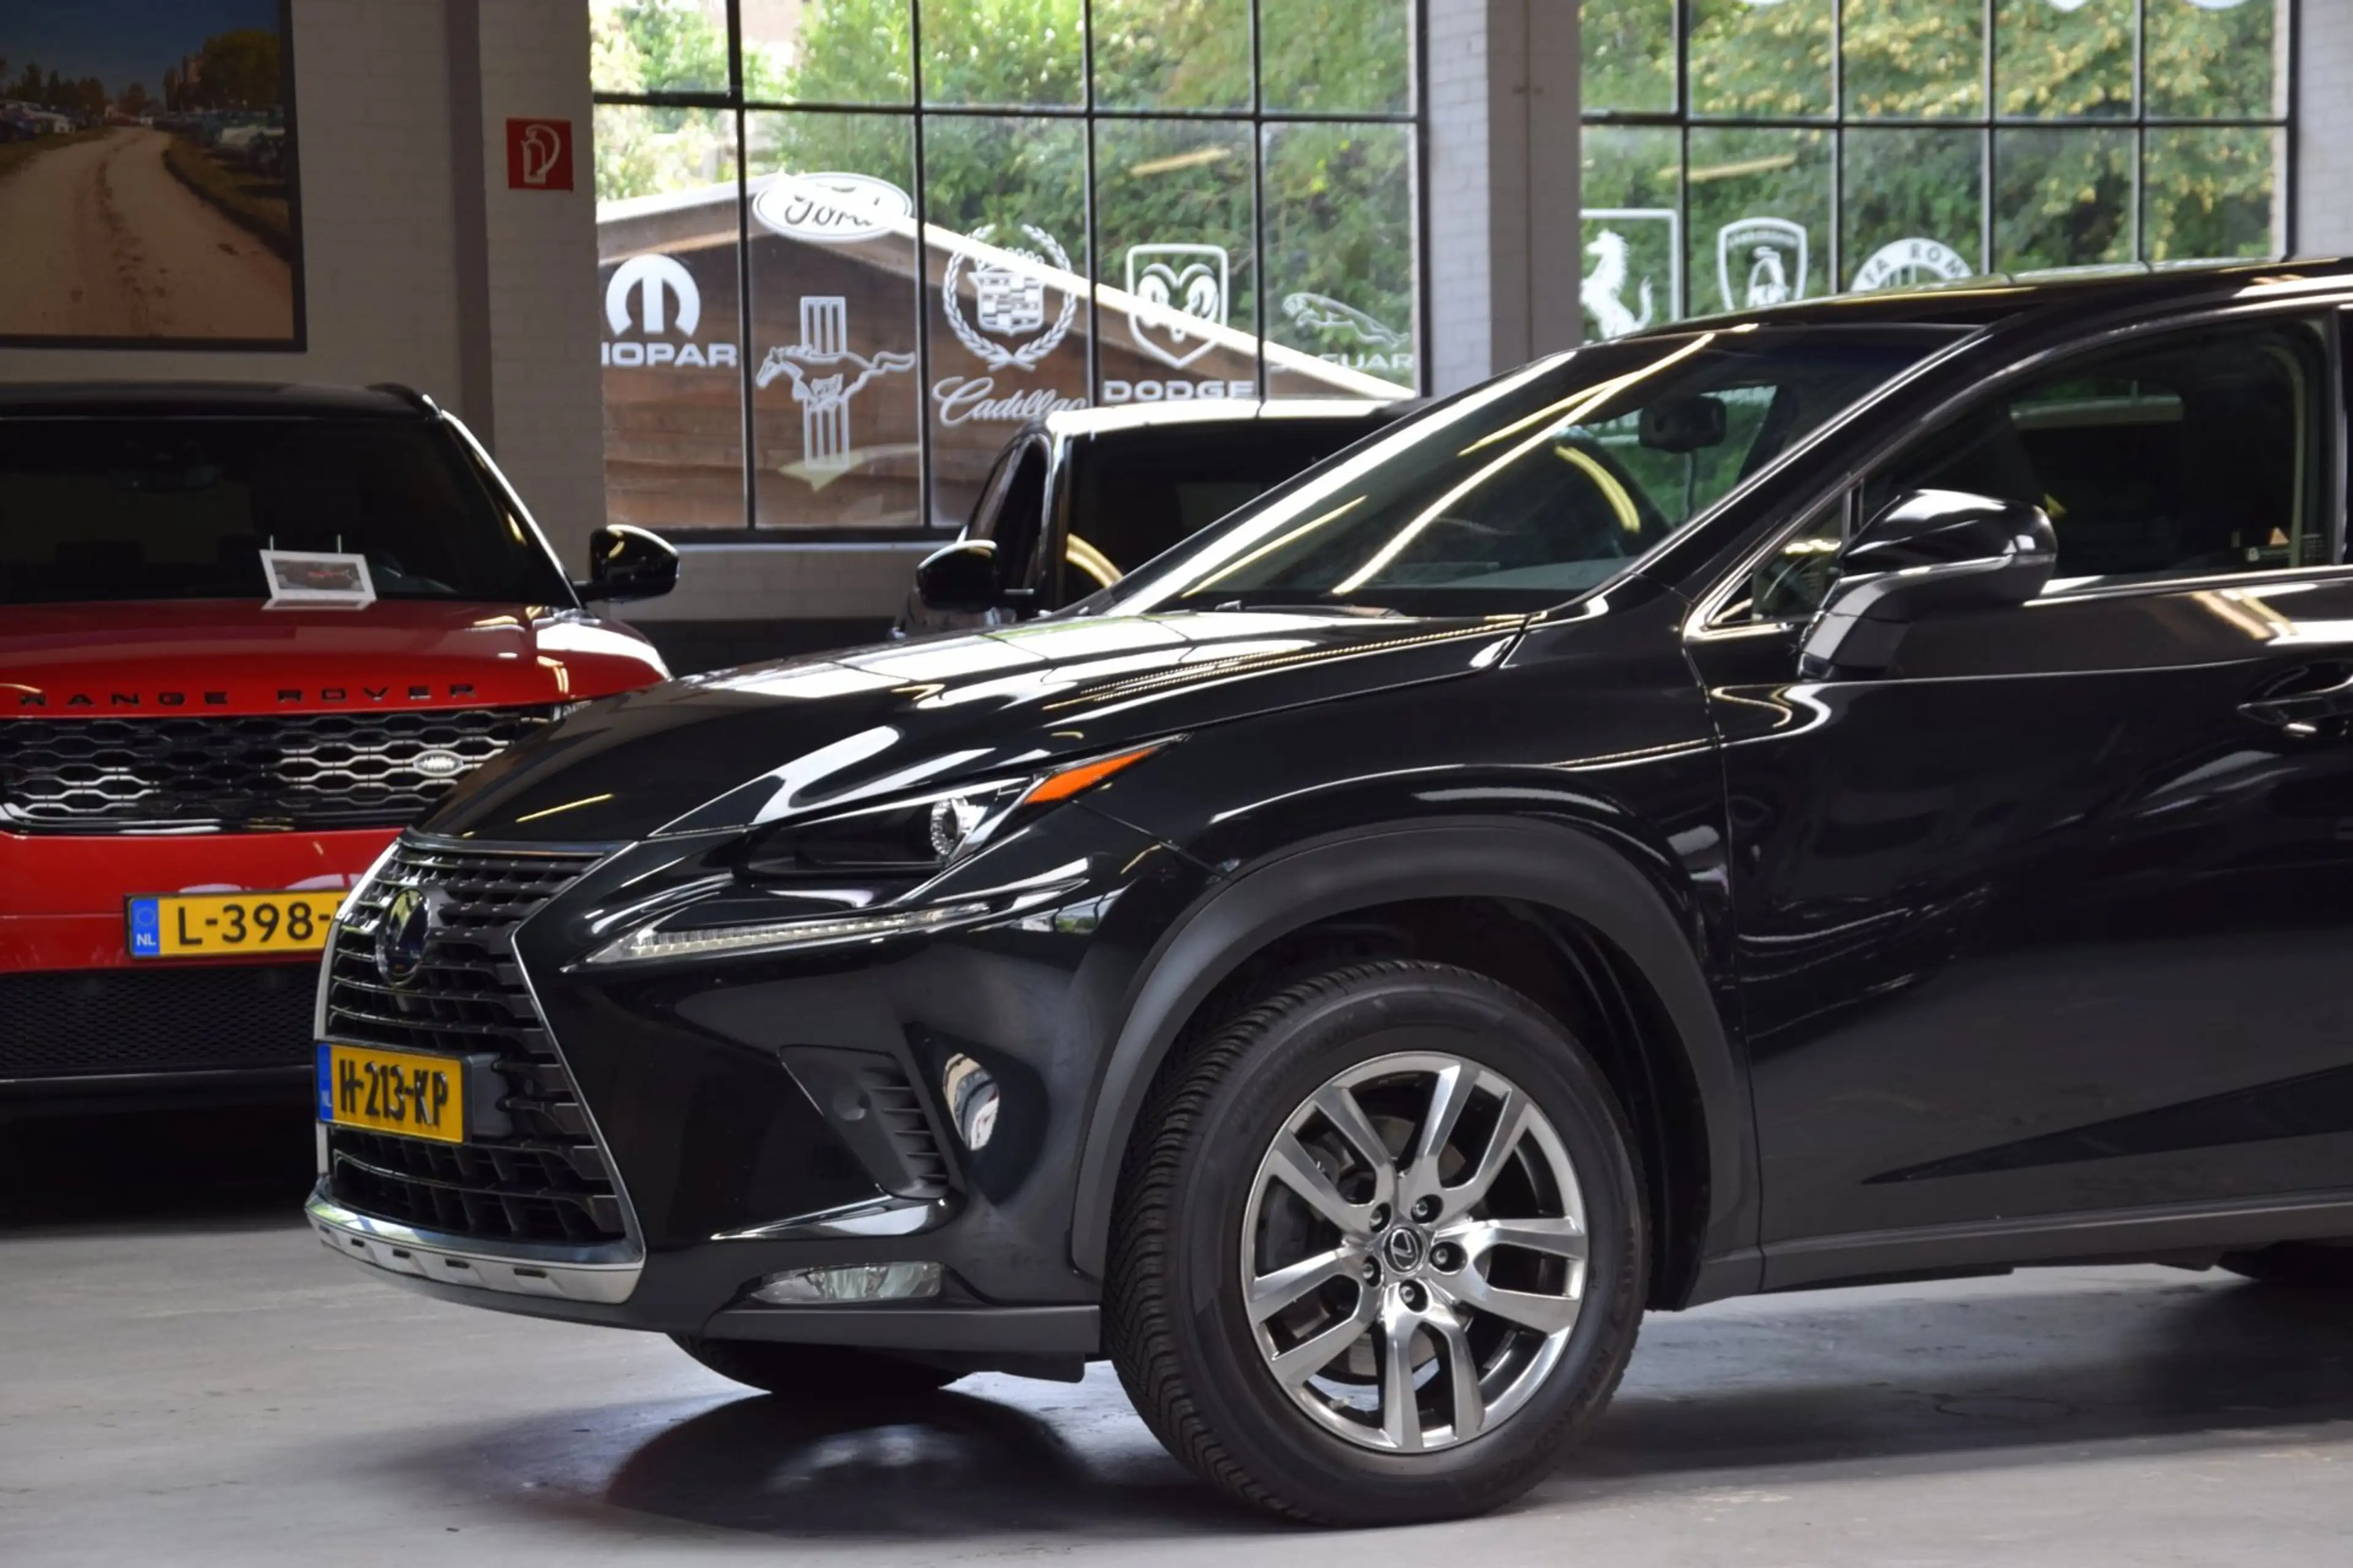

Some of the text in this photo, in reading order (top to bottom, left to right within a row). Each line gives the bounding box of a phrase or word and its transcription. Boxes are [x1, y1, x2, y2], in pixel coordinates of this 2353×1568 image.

[1104, 380, 1255, 403] DODGE
[20, 678, 476, 707] RANGE ROVER
[136, 902, 342, 946] NL L-398-
[339, 1059, 449, 1126] H-213-KP
